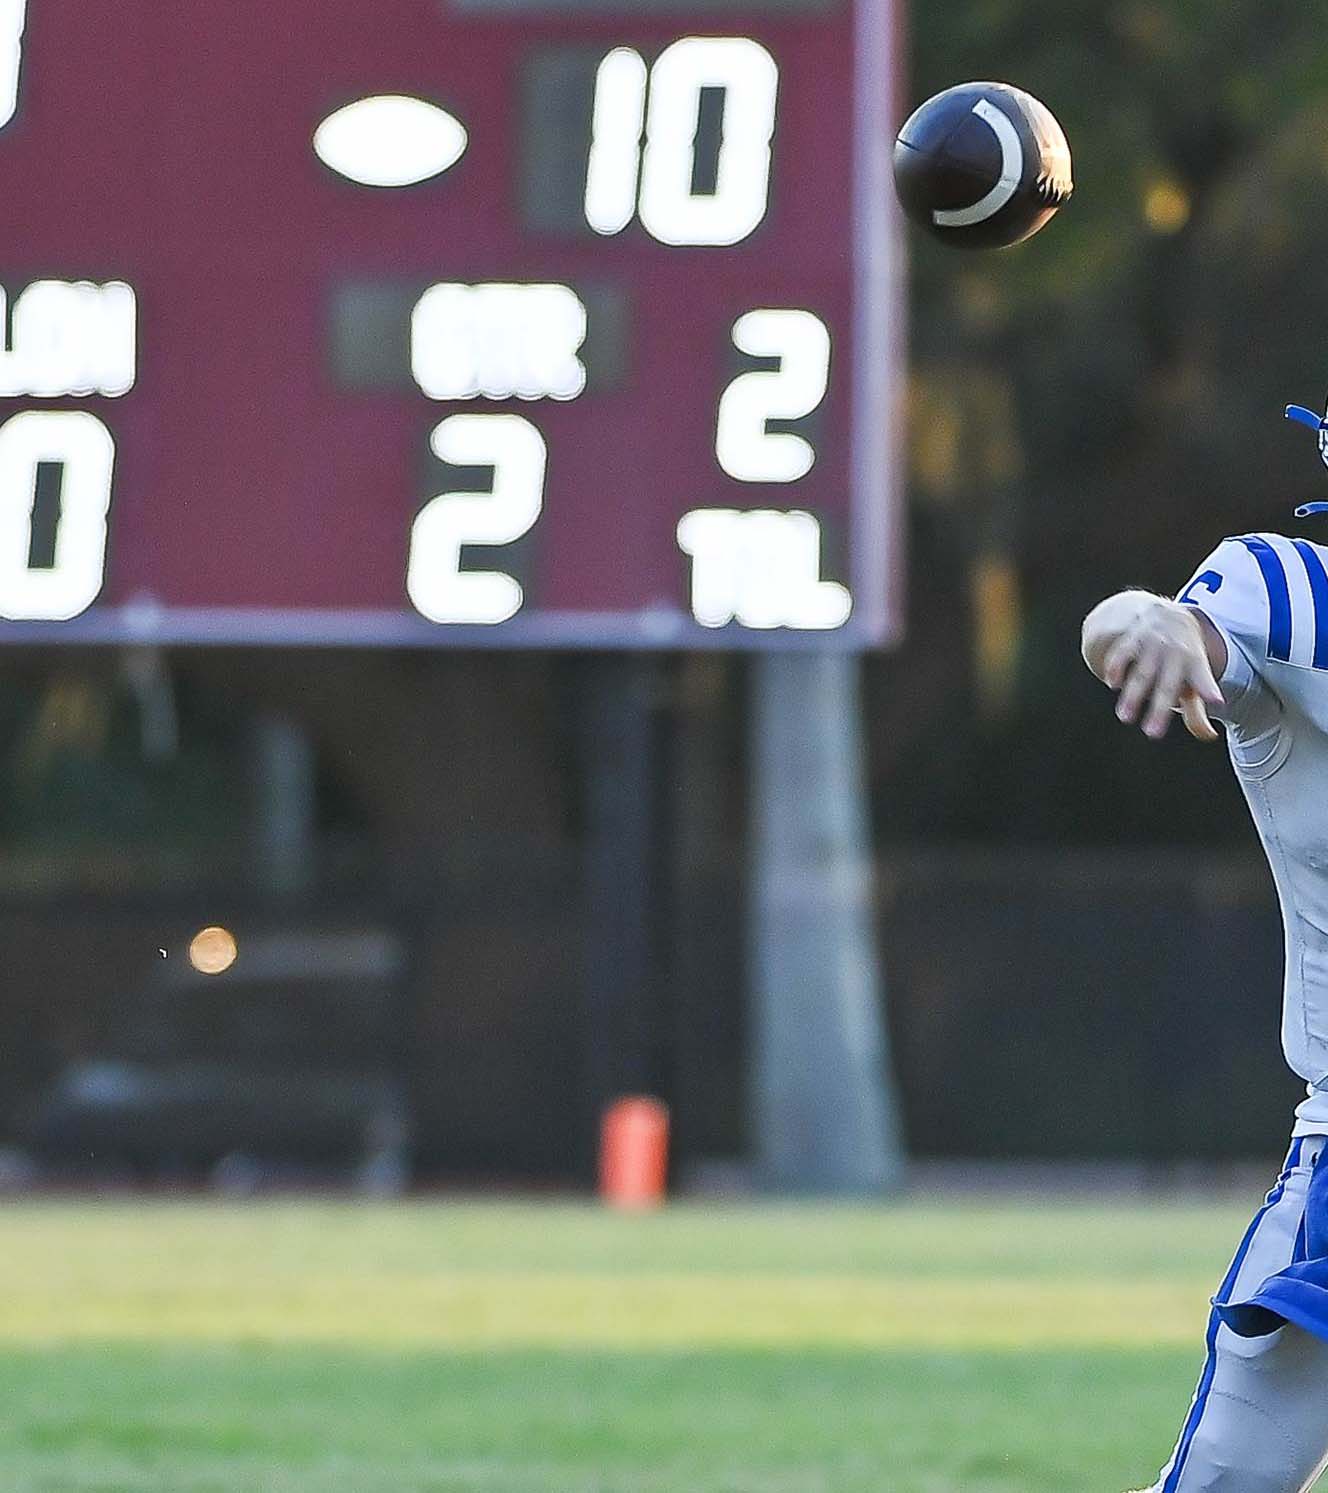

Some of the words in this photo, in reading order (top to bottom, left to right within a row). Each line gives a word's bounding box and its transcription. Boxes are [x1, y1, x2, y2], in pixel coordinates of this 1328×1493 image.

[585, 37, 779, 246] 10
[716, 309, 830, 482] 2
[407, 414, 547, 624] 2
